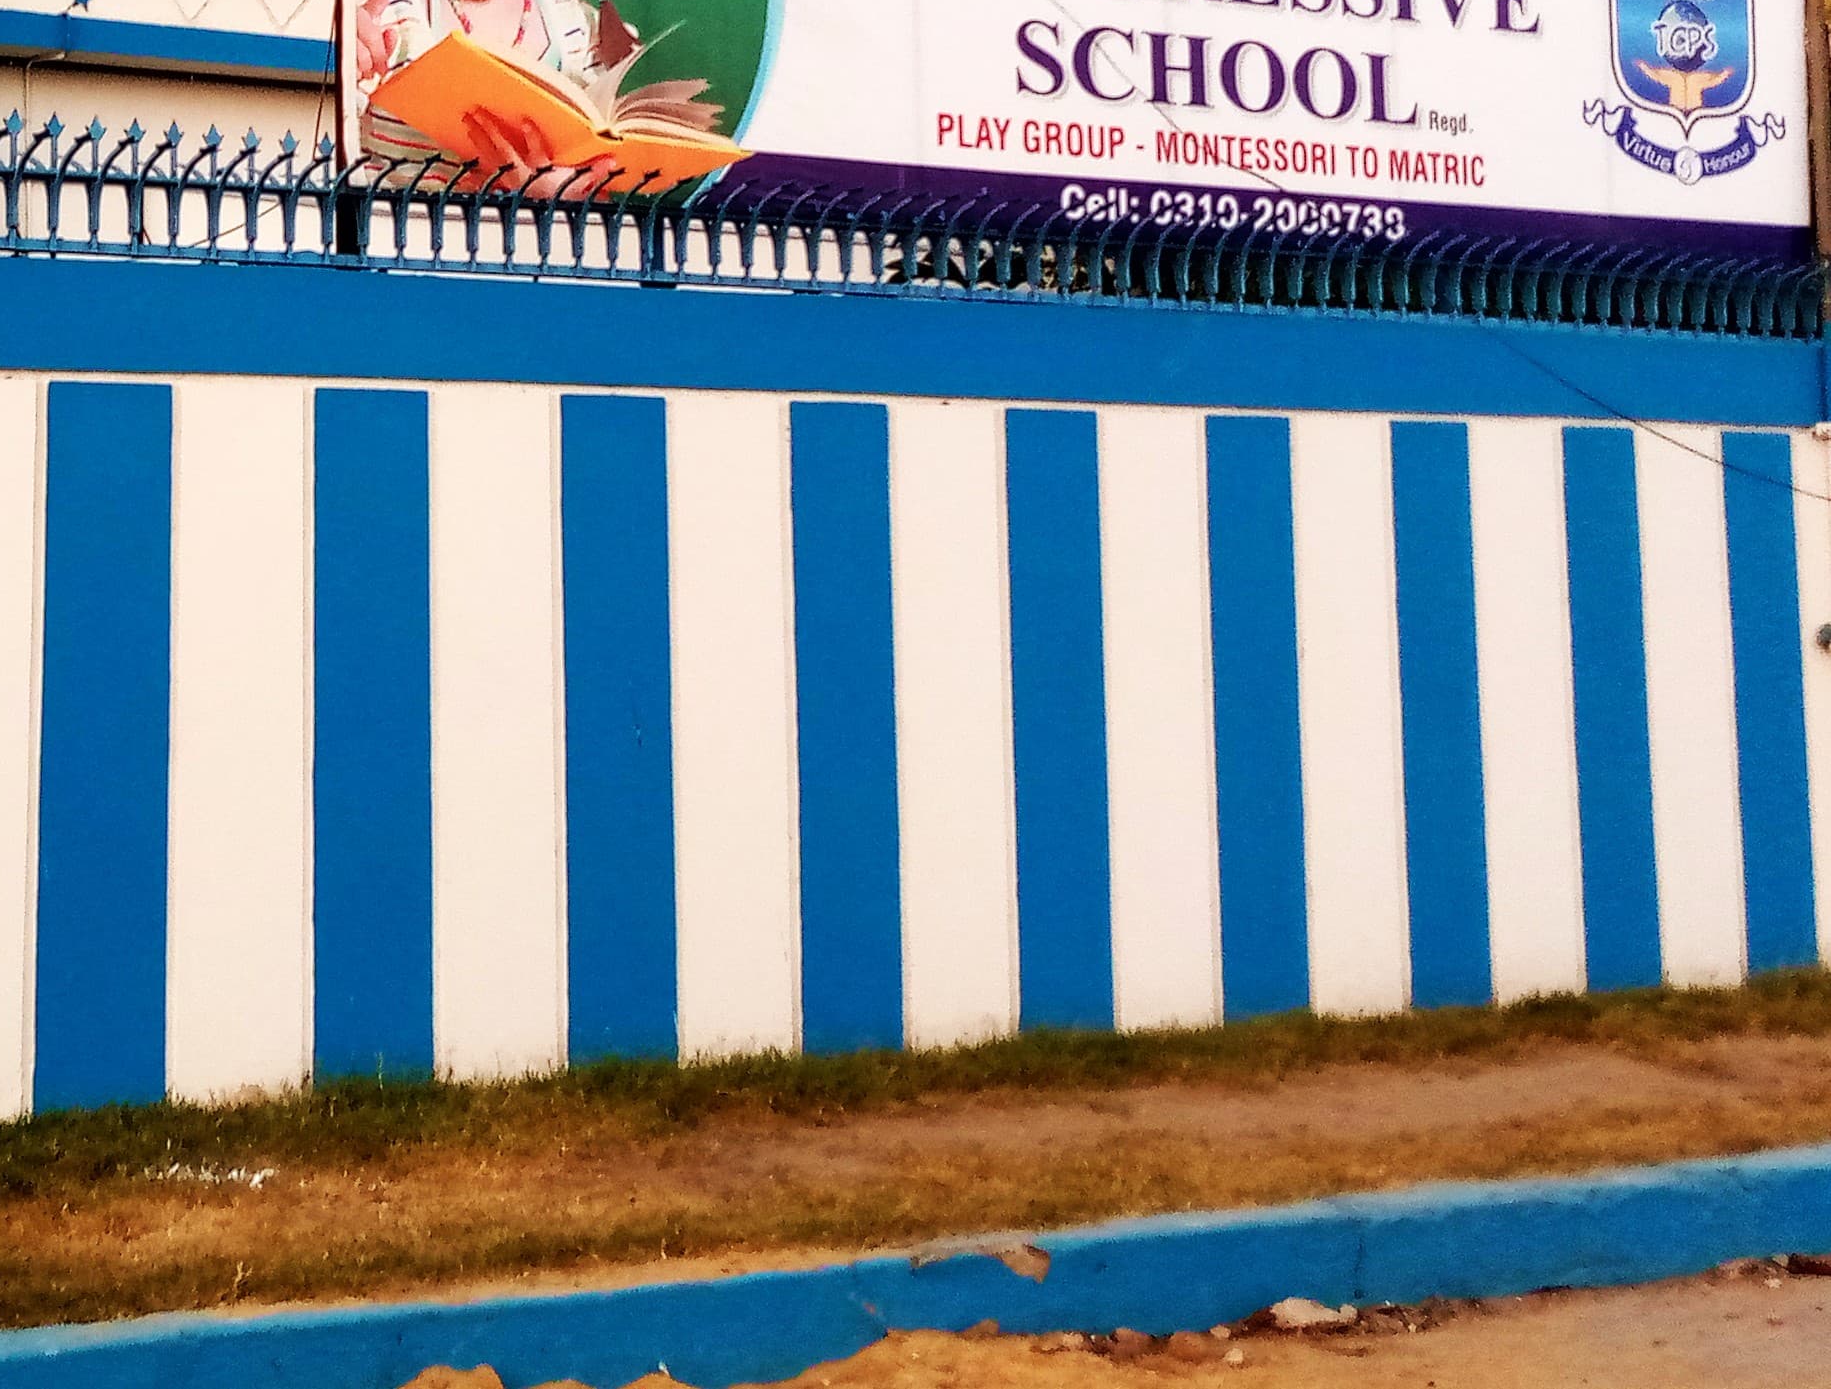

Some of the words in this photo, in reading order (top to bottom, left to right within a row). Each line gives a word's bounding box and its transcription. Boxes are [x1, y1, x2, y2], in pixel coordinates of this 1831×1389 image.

[1016, 20, 1418, 125] SCHOOL
[937, 114, 1010, 151] PLAY
[1023, 120, 1125, 159] GROUP
[1156, 129, 1336, 177] MONTESSORI
[1345, 145, 1379, 178] TO
[1389, 149, 1485, 187] MATRIC
[1623, 131, 1673, 172] Virtue
[1060, 183, 1140, 224] Cell:
